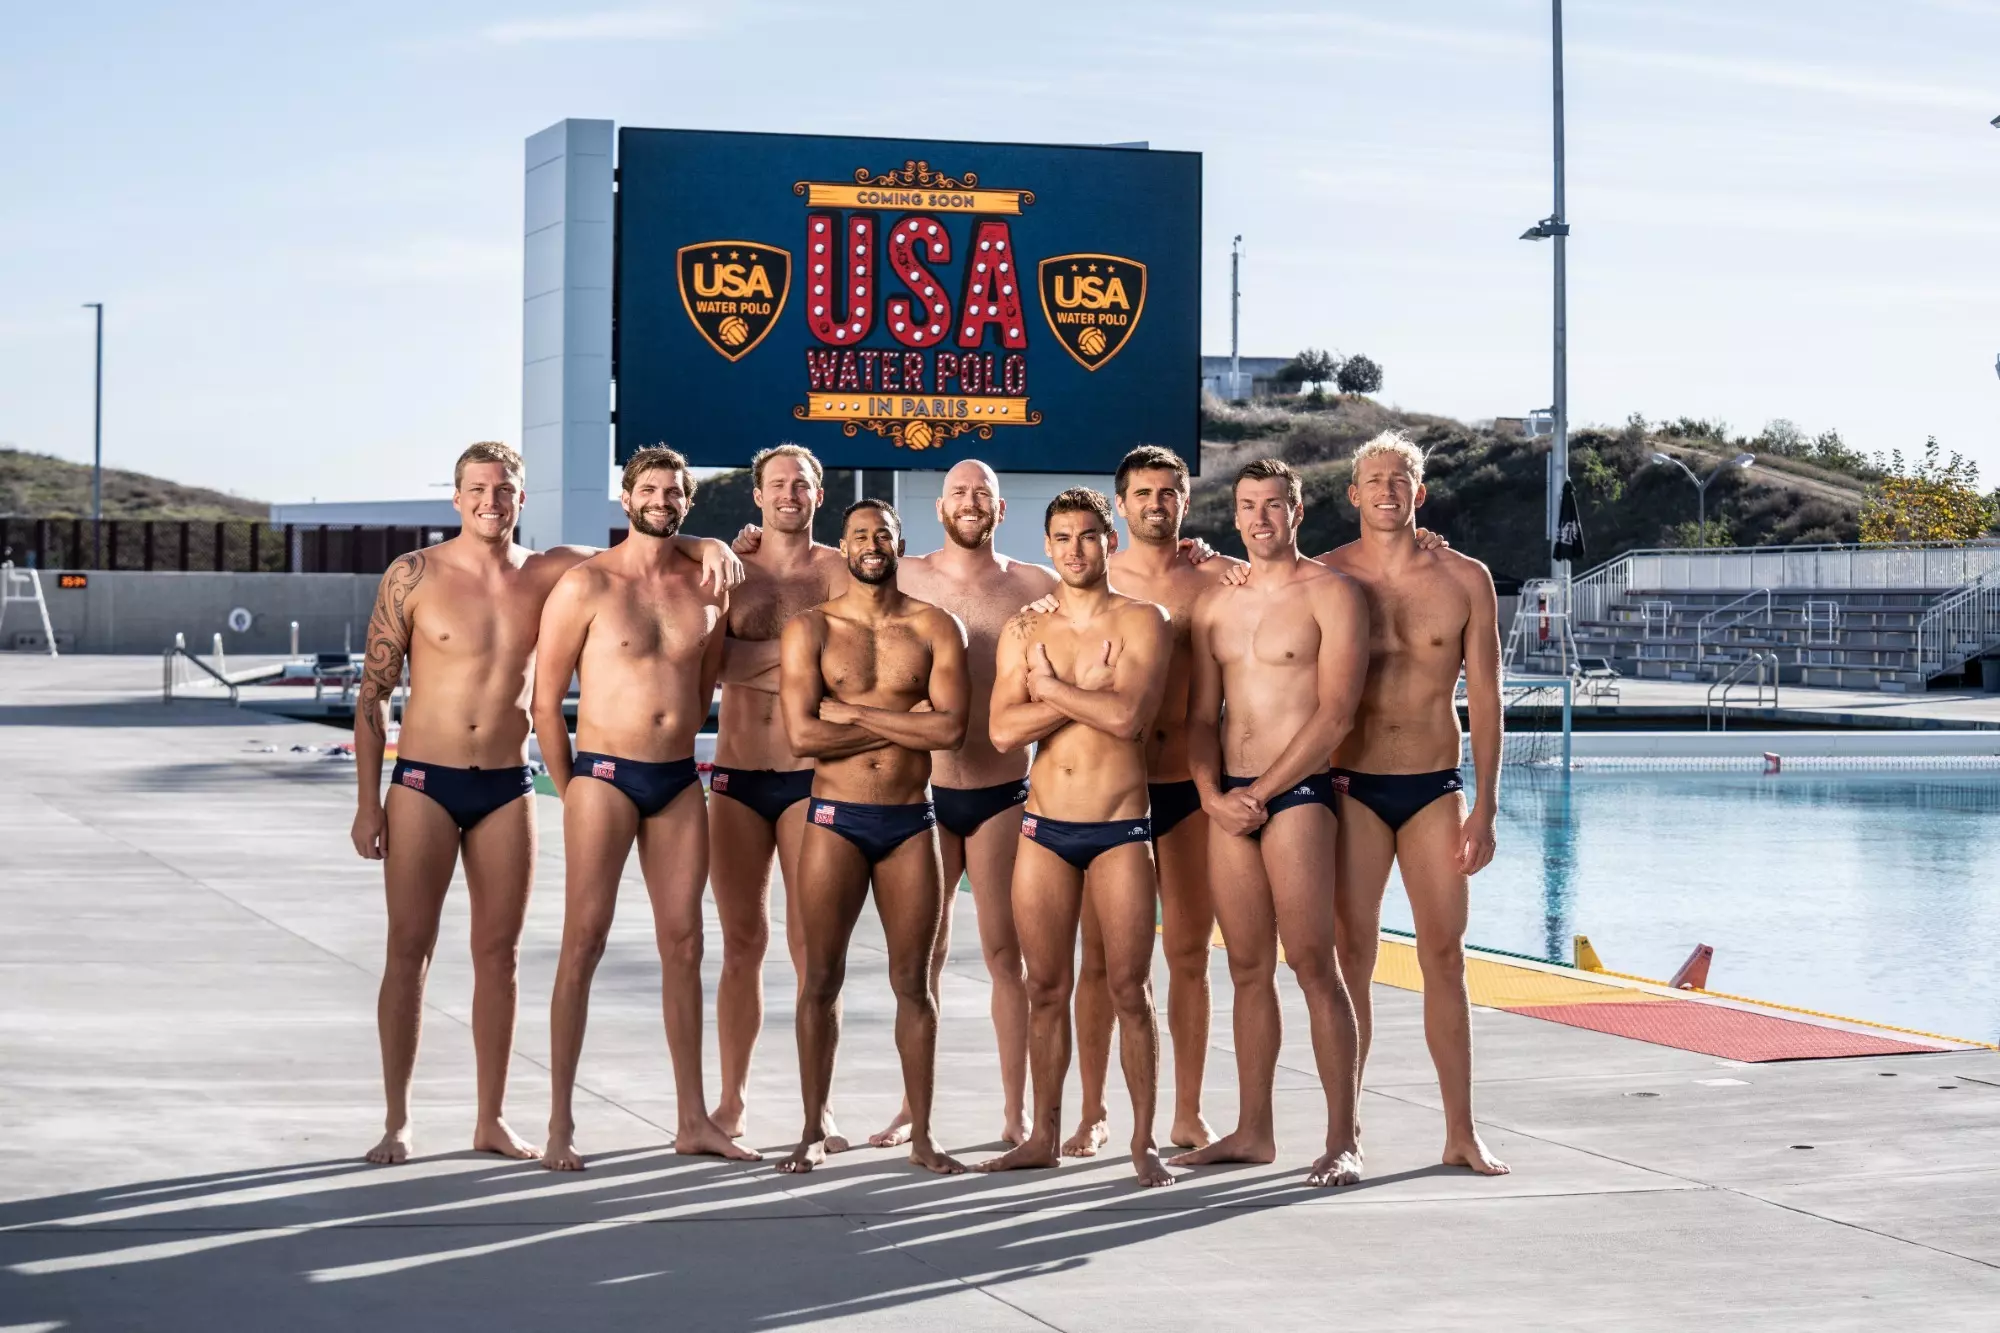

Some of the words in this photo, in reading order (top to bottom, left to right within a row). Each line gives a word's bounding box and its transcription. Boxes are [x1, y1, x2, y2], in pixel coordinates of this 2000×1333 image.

[856, 190, 924, 206] COMING
[927, 193, 975, 208] SOON
[693, 262, 774, 299] USA
[807, 214, 1028, 349] USA
[1054, 275, 1131, 310] USA
[696, 300, 737, 314] WATER
[740, 302, 771, 315] POLO
[1056, 311, 1095, 325] WATER
[1098, 313, 1128, 326] POLO
[806, 349, 925, 392] WATER
[935, 351, 1028, 396] POLO
[868, 397, 893, 417] IN
[901, 400, 969, 419] PARIS
[402, 775, 425, 790] USA
[592, 766, 615, 780] USA
